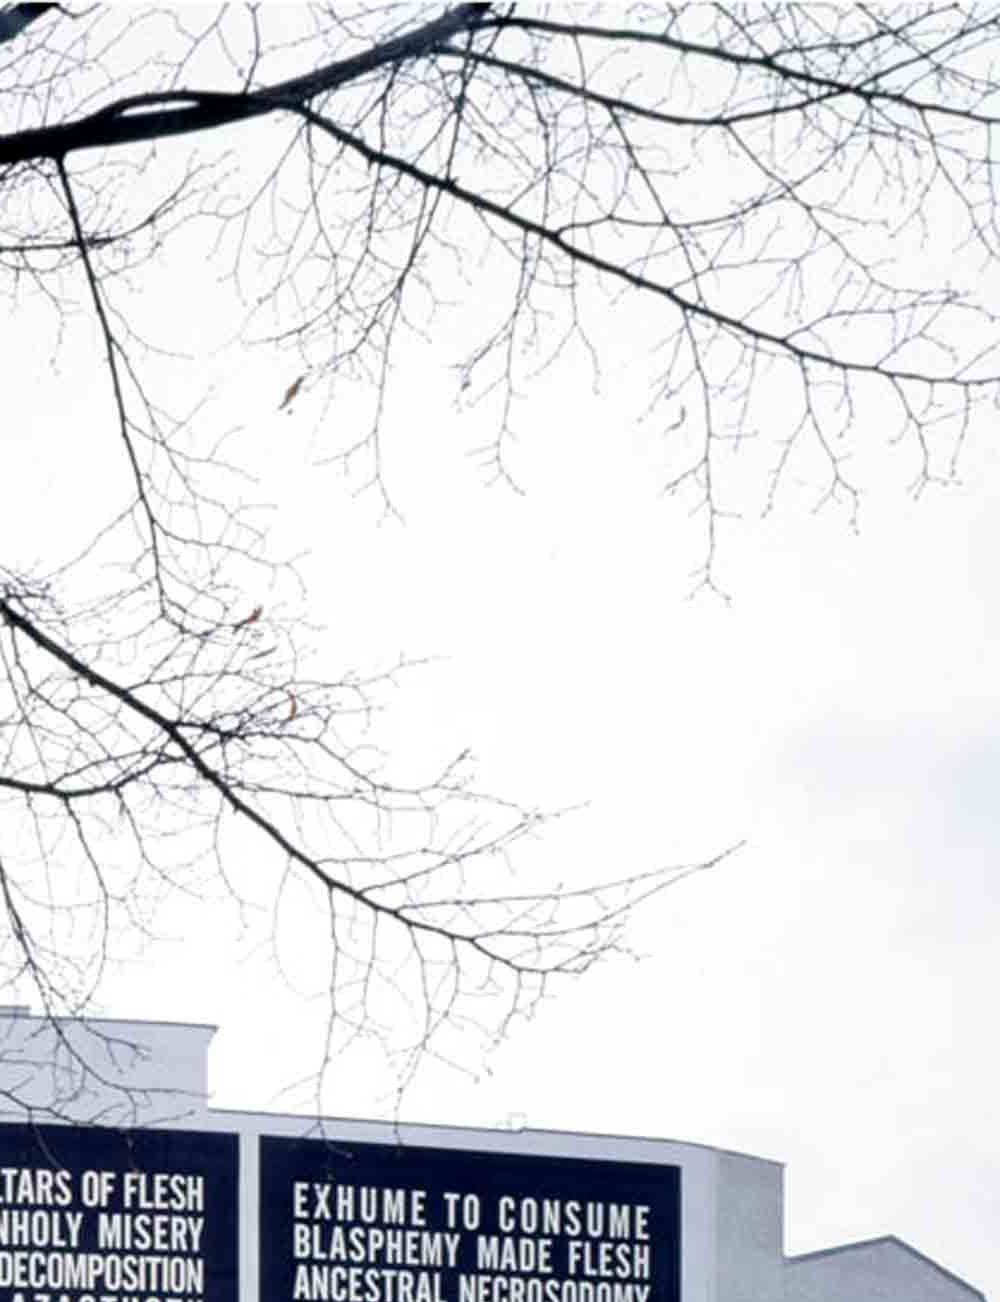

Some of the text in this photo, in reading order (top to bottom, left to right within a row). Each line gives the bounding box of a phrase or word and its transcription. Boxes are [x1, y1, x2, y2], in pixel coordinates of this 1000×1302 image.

[82, 1172, 114, 1206] OF
[124, 1174, 204, 1210] FLESH
[294, 1182, 649, 1239] EXHUME TO CONSUME
[99, 1214, 204, 1250] MISERY
[294, 1224, 650, 1277] BLASPHEMY MADE FLESH
